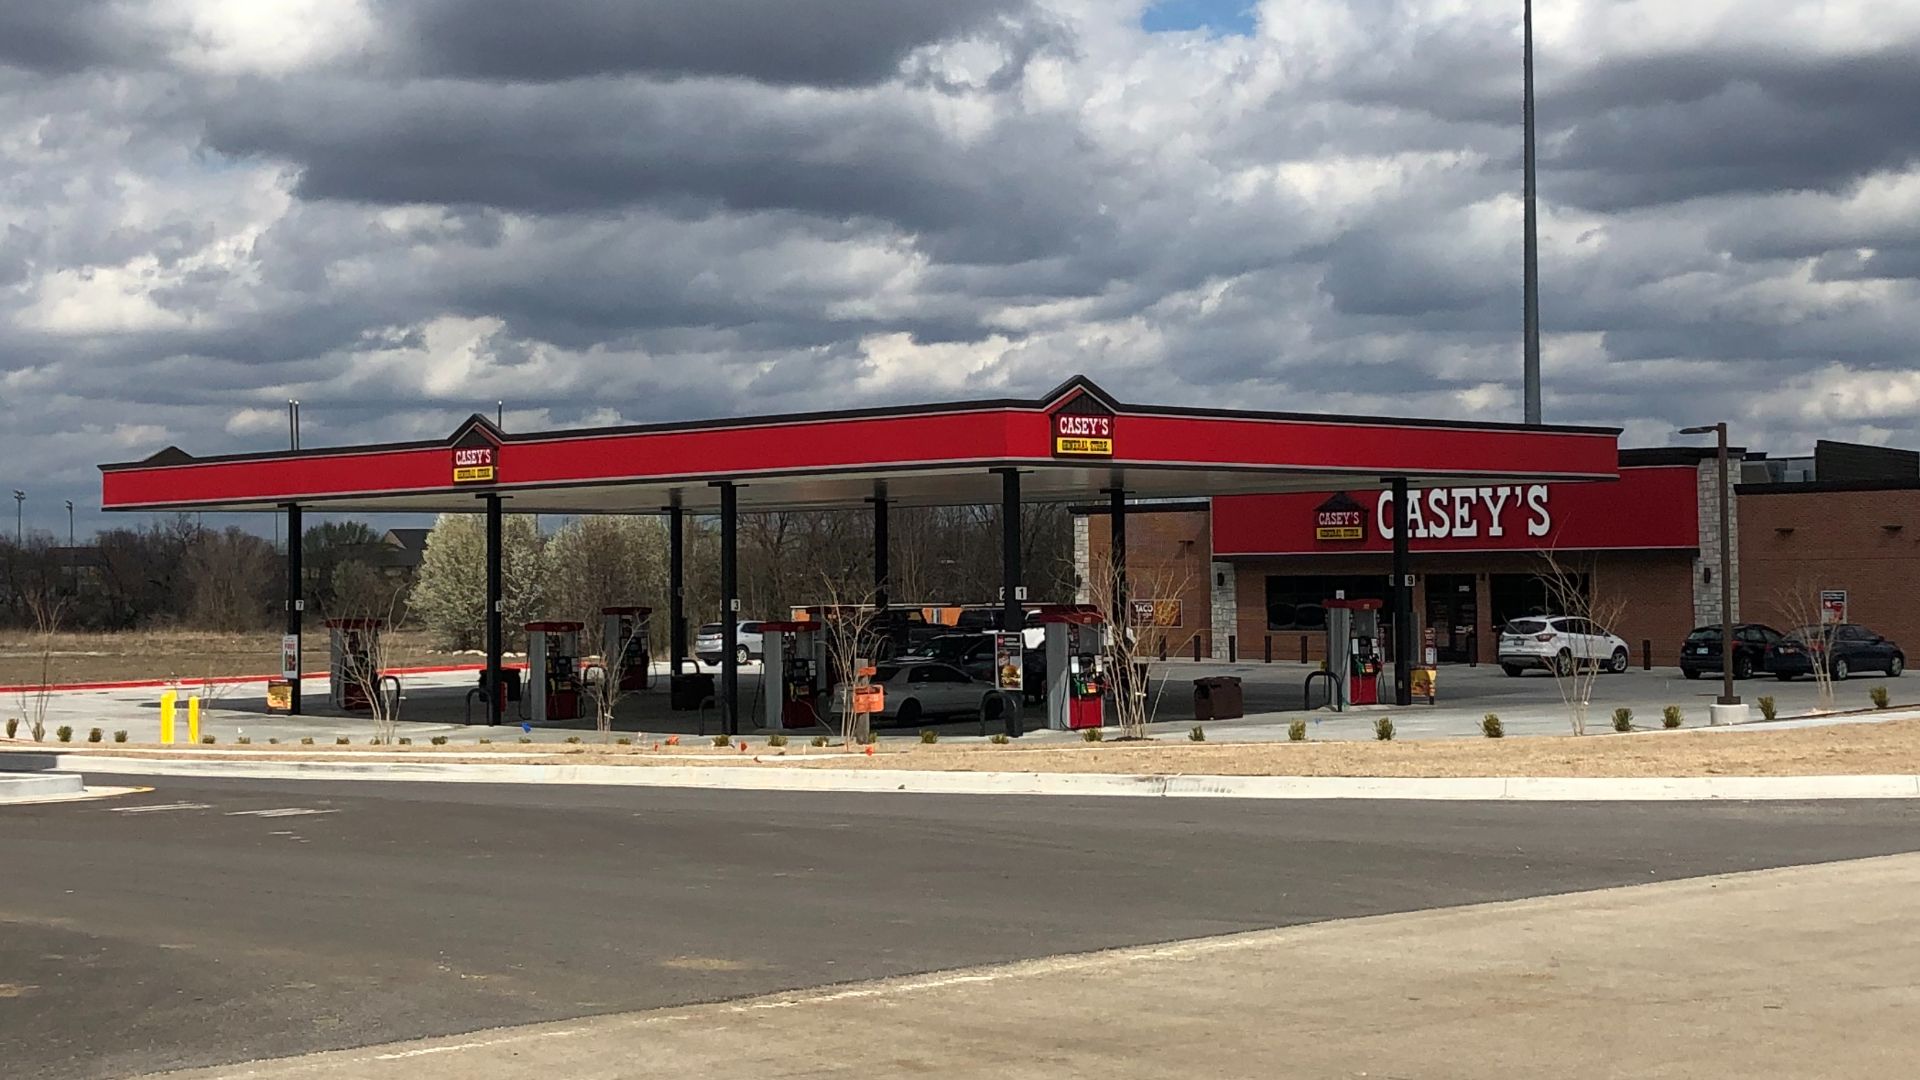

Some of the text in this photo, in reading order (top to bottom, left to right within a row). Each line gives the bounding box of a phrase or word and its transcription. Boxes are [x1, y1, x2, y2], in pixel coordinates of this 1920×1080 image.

[1060, 417, 1109, 435] CASEY'S
[455, 449, 491, 465] CASEY'S
[1318, 511, 1360, 526] CASEY'S
[1377, 485, 1550, 539] CASEY'S
